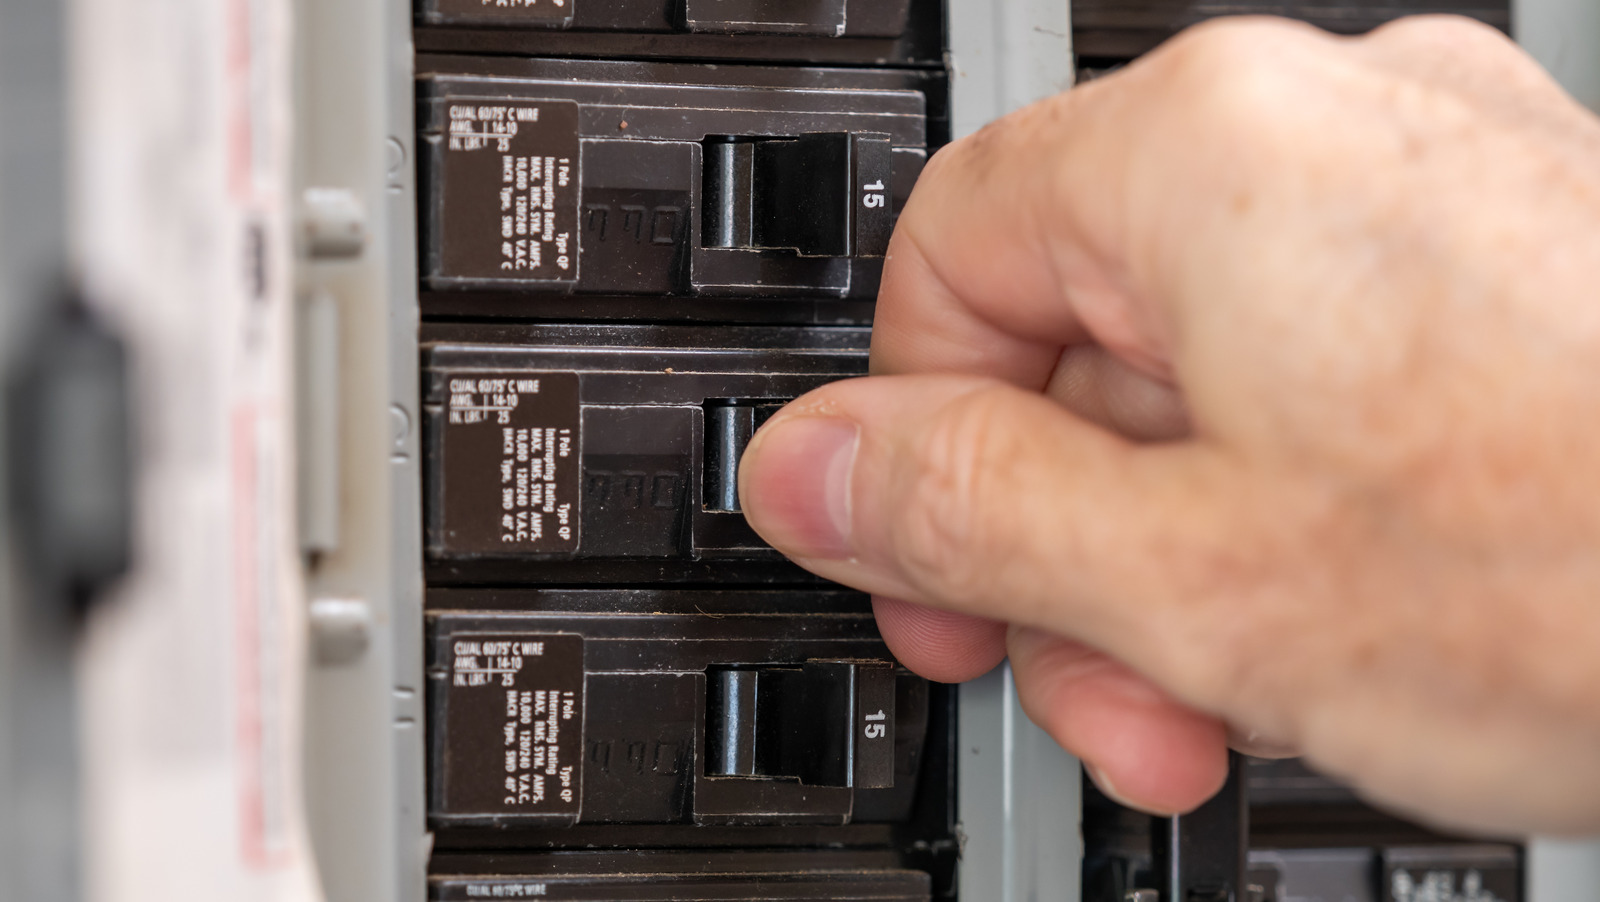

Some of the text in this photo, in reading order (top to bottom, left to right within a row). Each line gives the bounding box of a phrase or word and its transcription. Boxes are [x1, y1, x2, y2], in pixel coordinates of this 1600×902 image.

[507, 107, 515, 121] C
[516, 108, 538, 121] WIRE
[492, 121, 518, 136] 14-10
[497, 139, 509, 151] 25
[559, 166, 569, 186] Pole
[542, 157, 555, 242] Interrupting Rating
[863, 180, 884, 208] 15
[516, 157, 527, 270] 10,000 120/240 V.A.C.
[530, 156, 541, 270] MAX. RMS. SYM. AMPS.
[556, 232, 569, 254] Type
[557, 256, 568, 269] QP
[508, 380, 515, 393] C
[517, 380, 539, 393] WIRE
[493, 394, 518, 408] 14-10
[498, 411, 509, 424] 25
[560, 437, 570, 456] Pole
[543, 428, 556, 512] Interrupting Rating
[516, 429, 528, 541] 10,000 120/240 V.A.C.
[531, 428, 542, 541] MAX. RMS. SYM. AMPS.
[557, 503, 570, 524] Type
[558, 527, 570, 540] QP
[512, 642, 519, 655] C
[521, 642, 543, 655] WIRE
[497, 656, 522, 669] 14-10
[501, 673, 514, 686] 25
[563, 700, 573, 719] Pole
[545, 691, 559, 774] Interrupting Rating
[865, 710, 885, 738] 15
[519, 692, 531, 803] 10,000 120/240 V.A.C.
[533, 691, 545, 803] MAX. RMS. SYM. AMPS.
[560, 766, 572, 787] Type
[560, 789, 572, 802] QP
